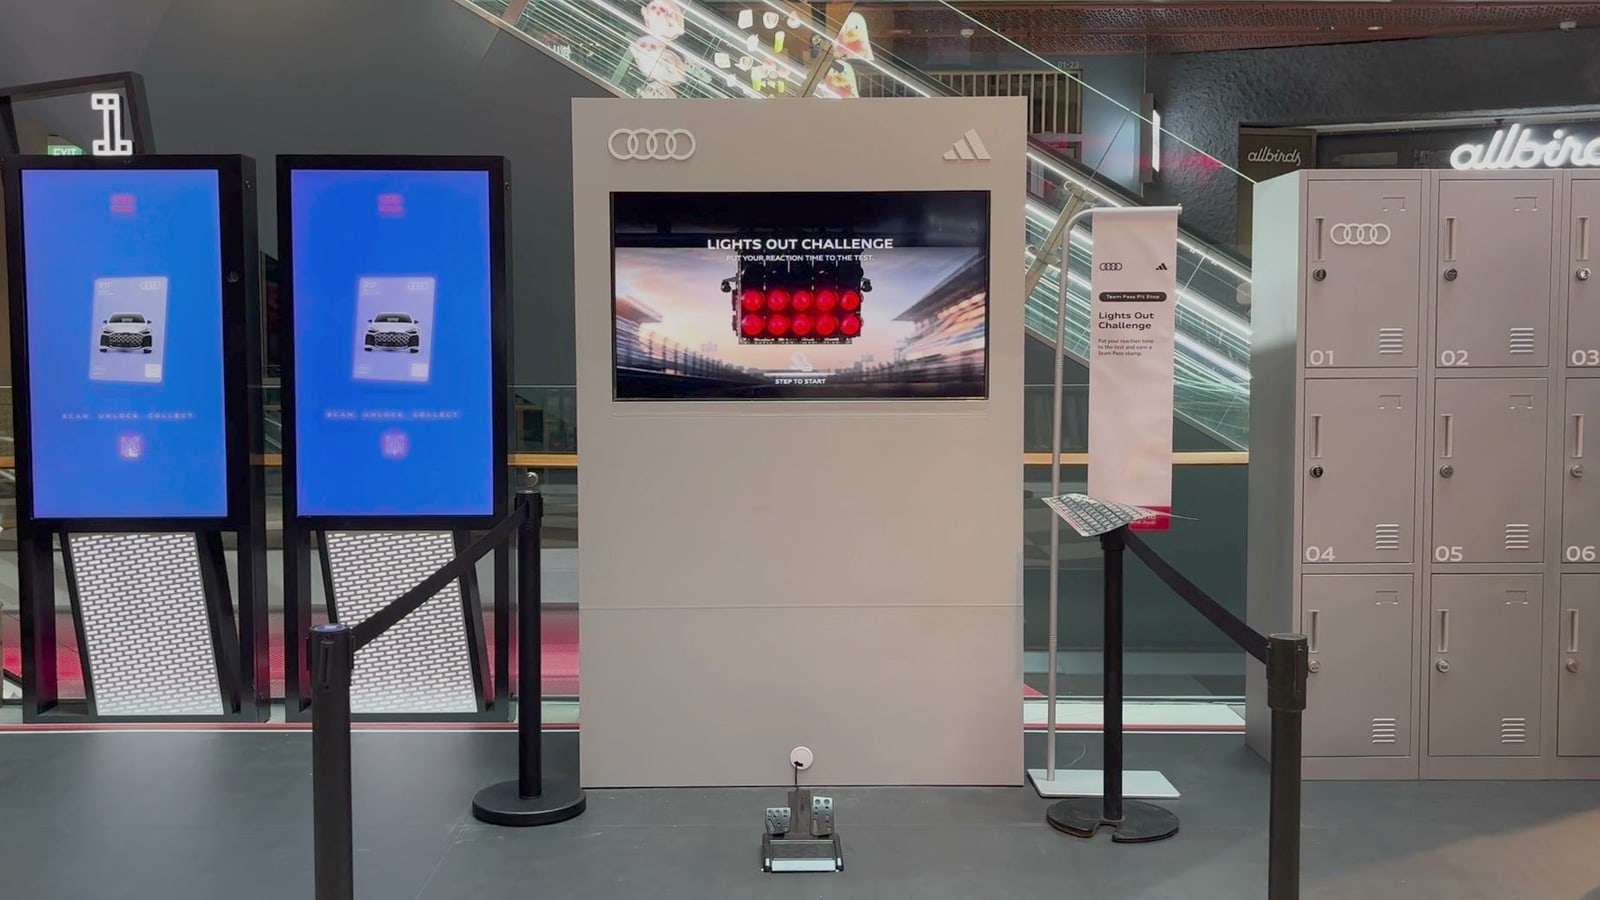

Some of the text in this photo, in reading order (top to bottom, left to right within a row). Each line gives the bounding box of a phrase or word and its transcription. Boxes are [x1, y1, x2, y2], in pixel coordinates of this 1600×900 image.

[1057, 61, 1080, 69] 01-23
[1248, 146, 1301, 166] allbirds
[707, 239, 894, 250] LIGHTS OUT CHALLENGE
[1099, 312, 1131, 320] Lights
[1098, 322, 1152, 330] Challenge
[1309, 350, 1334, 366] 01
[1441, 350, 1469, 366] 02
[1571, 350, 1599, 366] 03
[1305, 546, 1336, 561] 04
[1435, 546, 1463, 561] 05
[1566, 546, 1596, 561] 06
